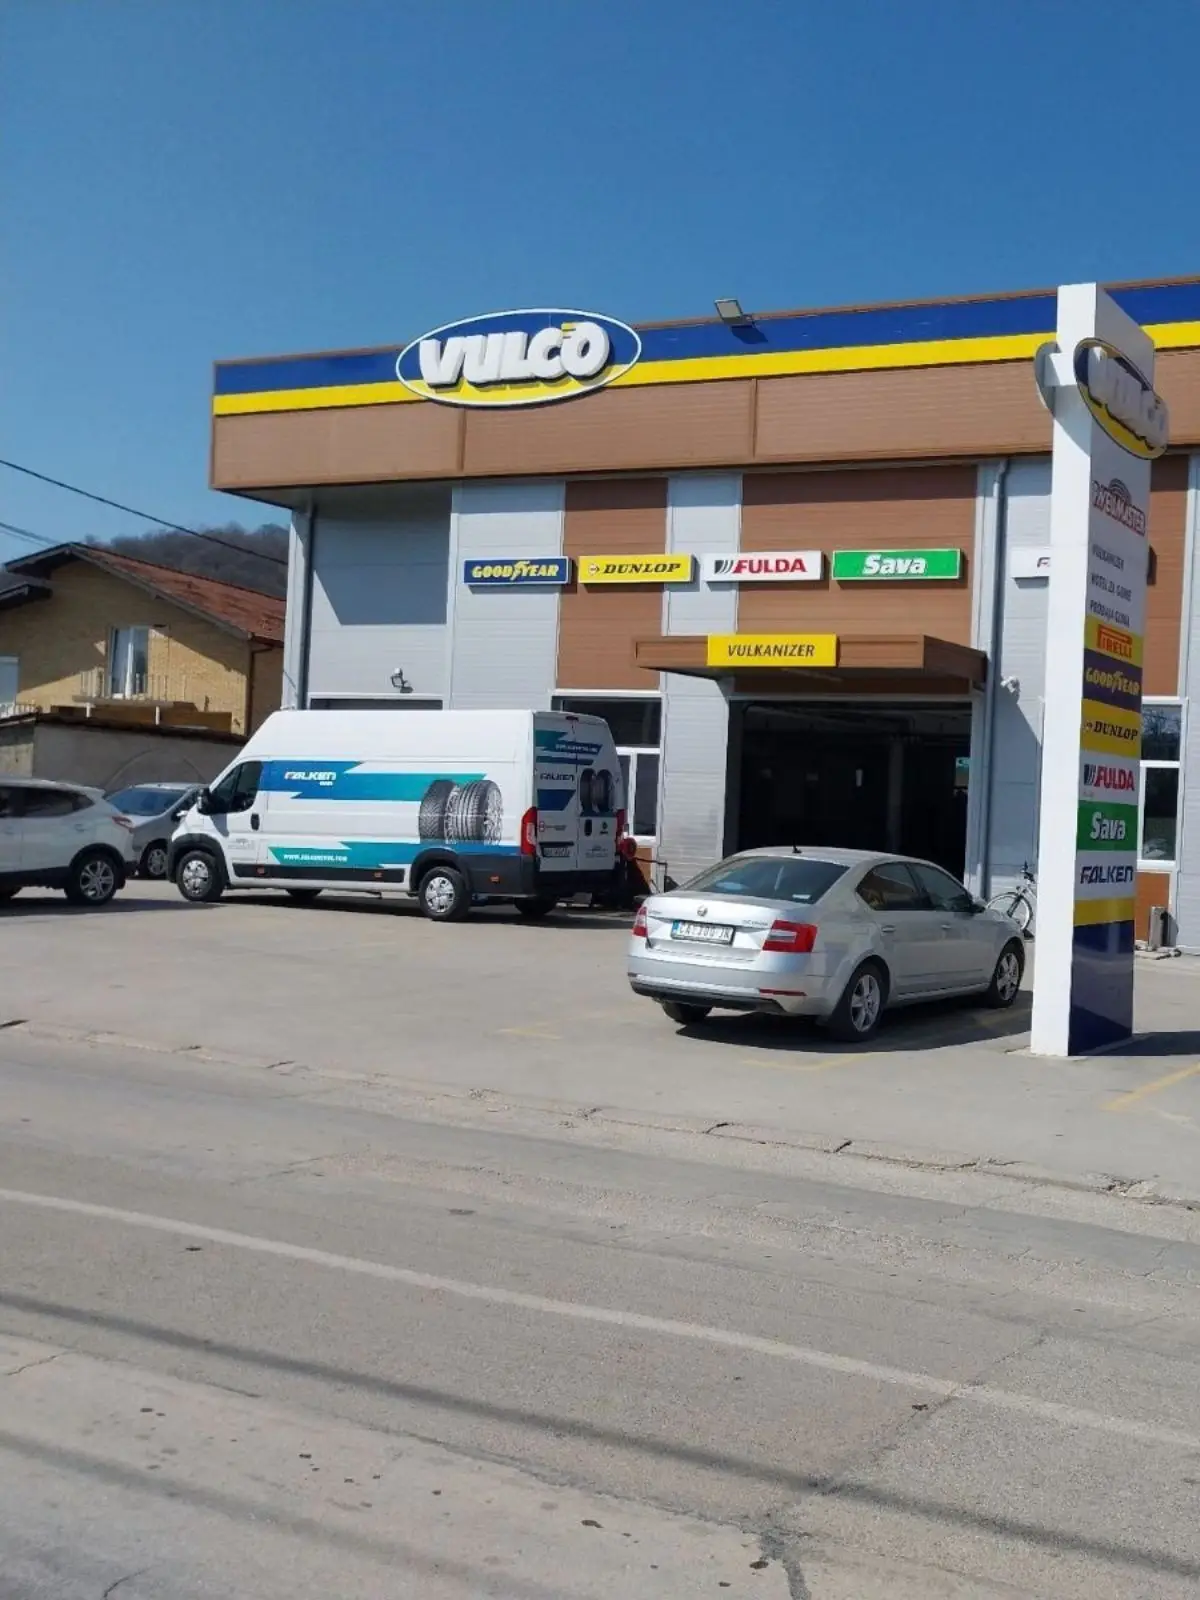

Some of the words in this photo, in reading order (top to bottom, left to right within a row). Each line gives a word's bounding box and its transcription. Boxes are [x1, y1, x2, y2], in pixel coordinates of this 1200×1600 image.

[419, 321, 609, 387] VULCO
[472, 560, 559, 580] GOODYEAR
[603, 562, 680, 575] DUNLOP
[732, 558, 807, 574] FULDA
[862, 554, 926, 575] Sava
[728, 643, 815, 658] VULKANIZER
[1097, 623, 1133, 658] PIRELLI
[1085, 666, 1140, 696] GOODYEAR
[1093, 720, 1139, 741] DUNLOP
[284, 771, 337, 781] FALKEN
[1093, 765, 1136, 792] FULDA
[1090, 811, 1126, 841] Sava
[1080, 865, 1134, 884] FALKEN
